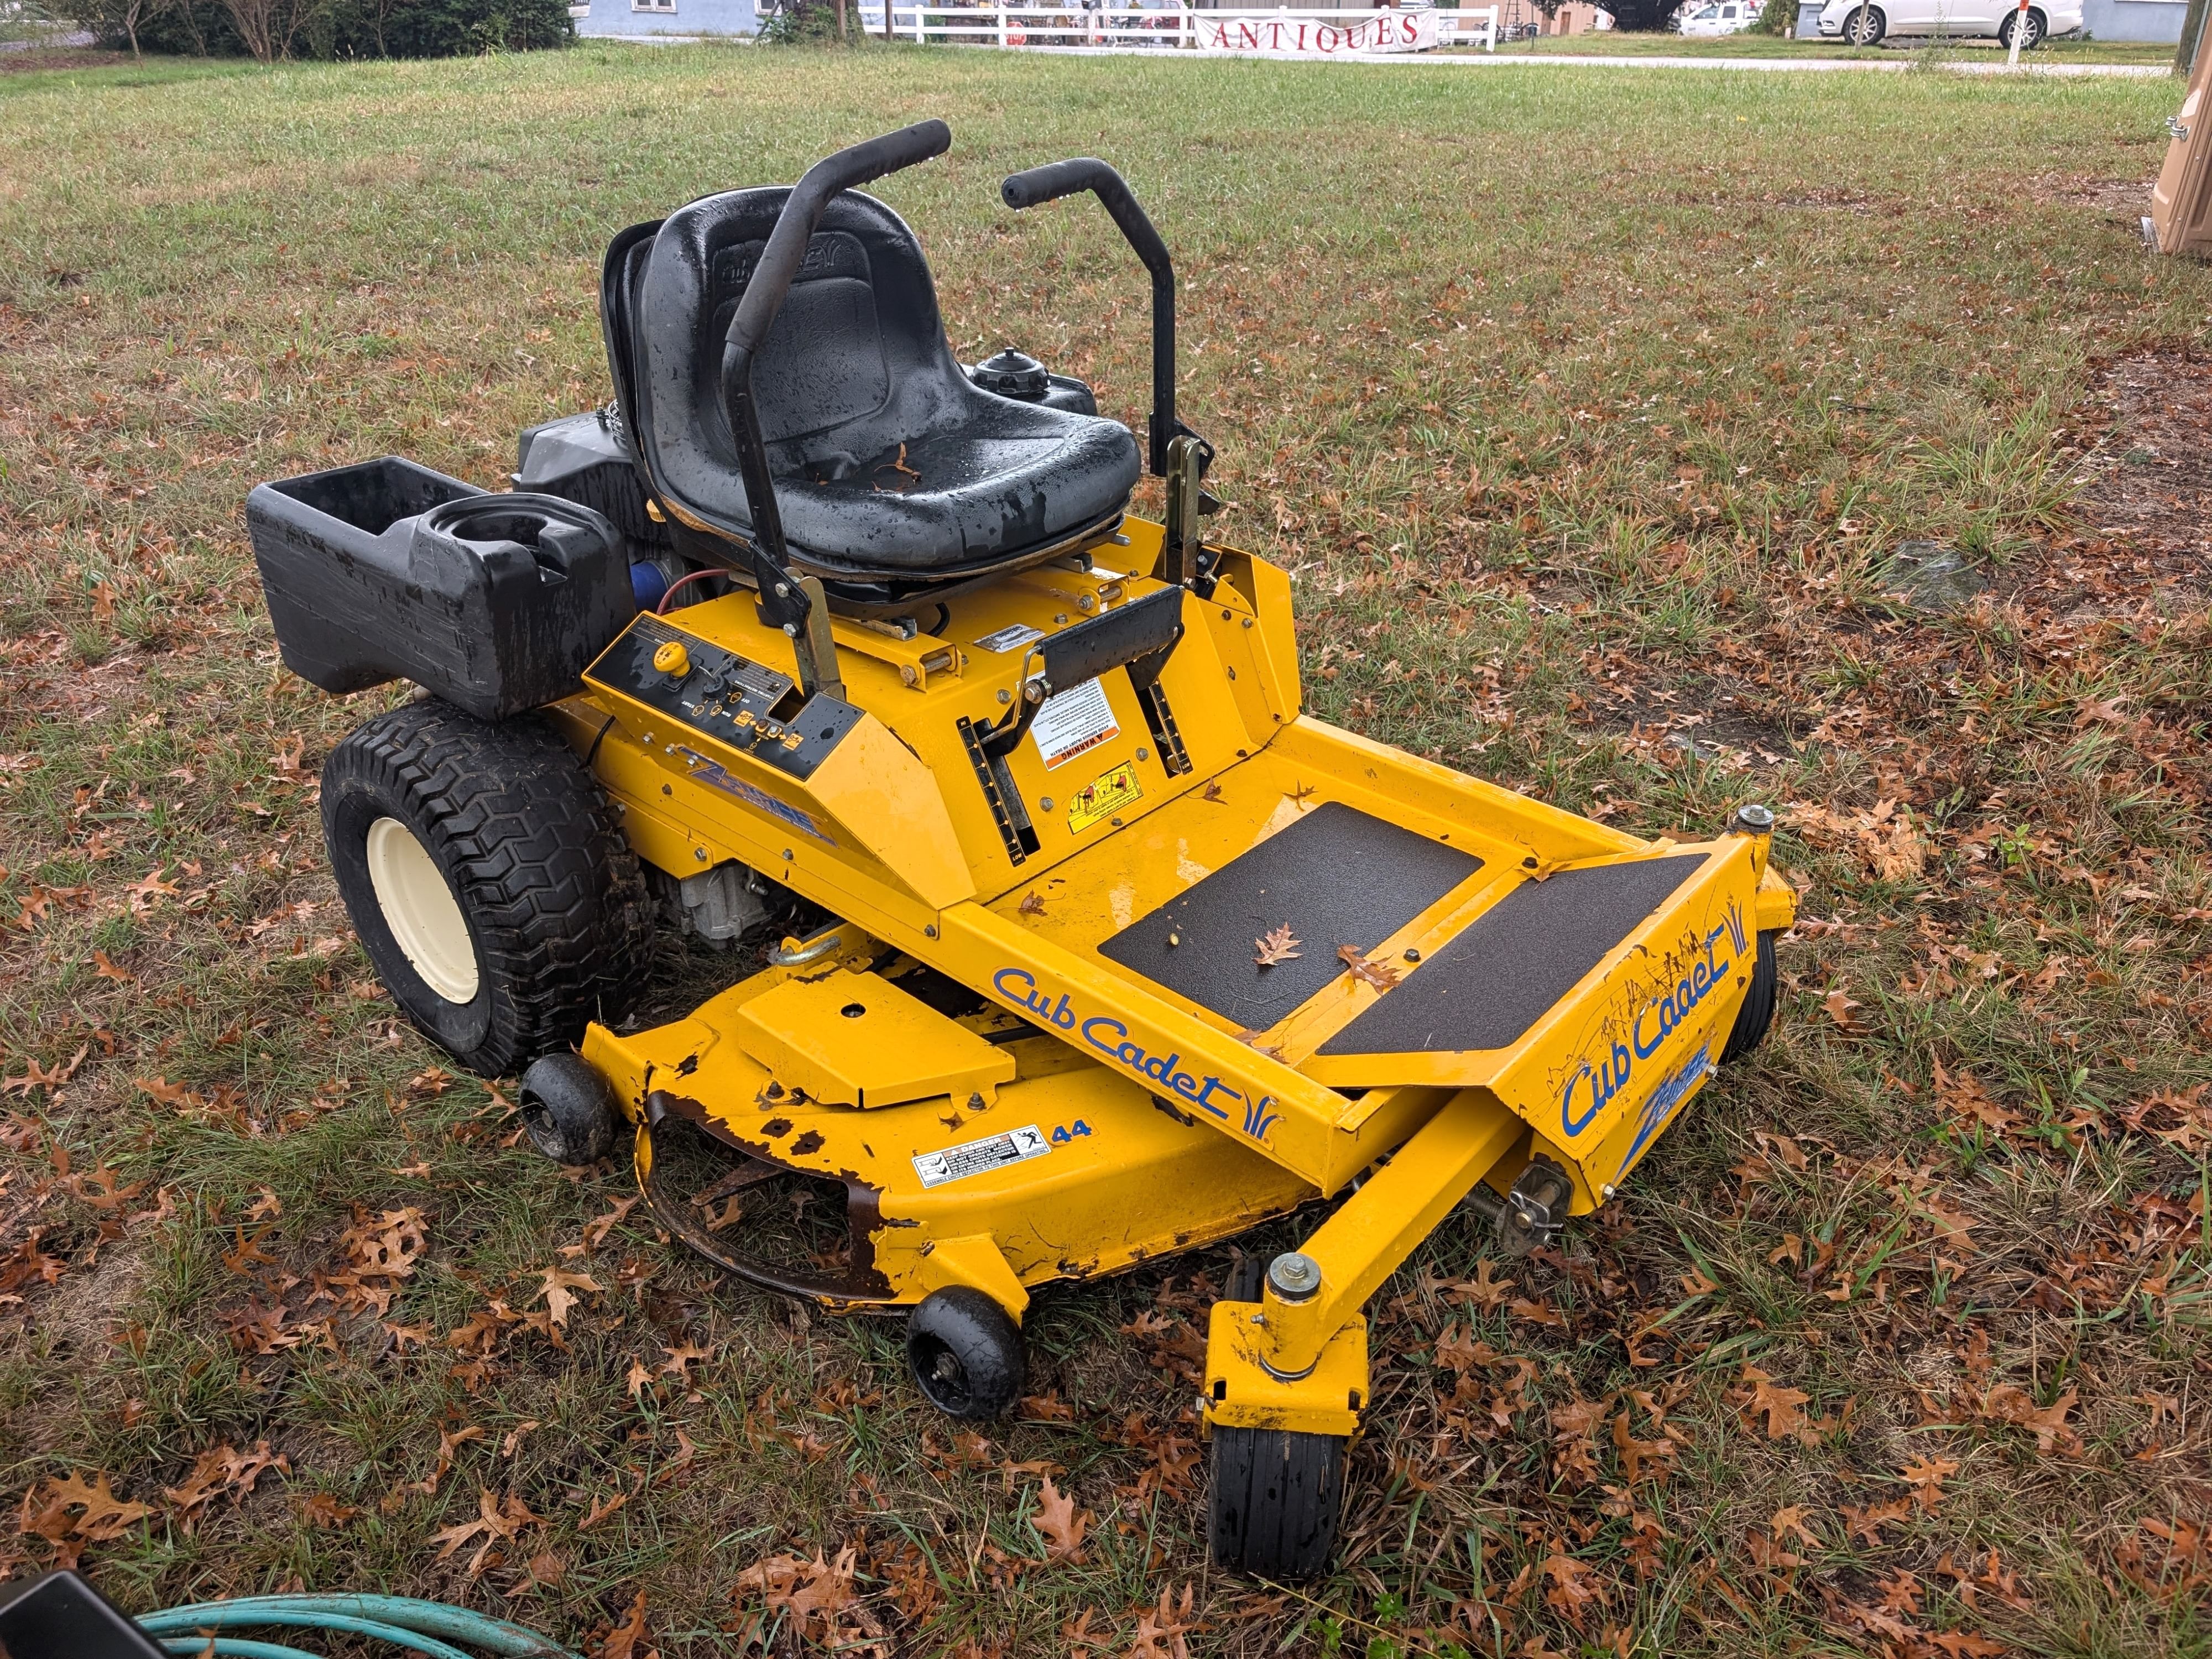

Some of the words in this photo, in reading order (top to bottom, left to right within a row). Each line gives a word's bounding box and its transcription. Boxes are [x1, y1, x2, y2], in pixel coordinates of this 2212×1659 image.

[1211, 15, 1417, 53] ANTIQUES
[733, 679, 758, 692] INSTRUCTIONS
[681, 700, 695, 708] START
[1097, 724, 1109, 732] AVOID
[1082, 730, 1097, 740] SERIOUS
[1068, 738, 1082, 747] INJURY
[1050, 748, 1062, 757] DEATH
[1060, 737, 1096, 761] WARNING
[1013, 853, 1021, 861] LOW
[1562, 1040, 1631, 1137] Cub
[1633, 924, 1729, 1060] Cadet
[994, 968, 1076, 1029] Cub
[1082, 1017, 1242, 1119] Cadet
[1051, 1119, 1093, 1143] 44
[960, 1137, 1002, 1152] DANGER
[948, 1159, 969, 1167] UNLESS
[985, 1146, 1014, 1156] DEFLECTOR
[967, 1149, 991, 1158] OPERATE
[989, 1151, 1011, 1159] CATCHER
[966, 1161, 985, 1170] PROPER
[926, 1177, 947, 1186] ASSEMBLE
[961, 1166, 984, 1176] DEFLECTOR
